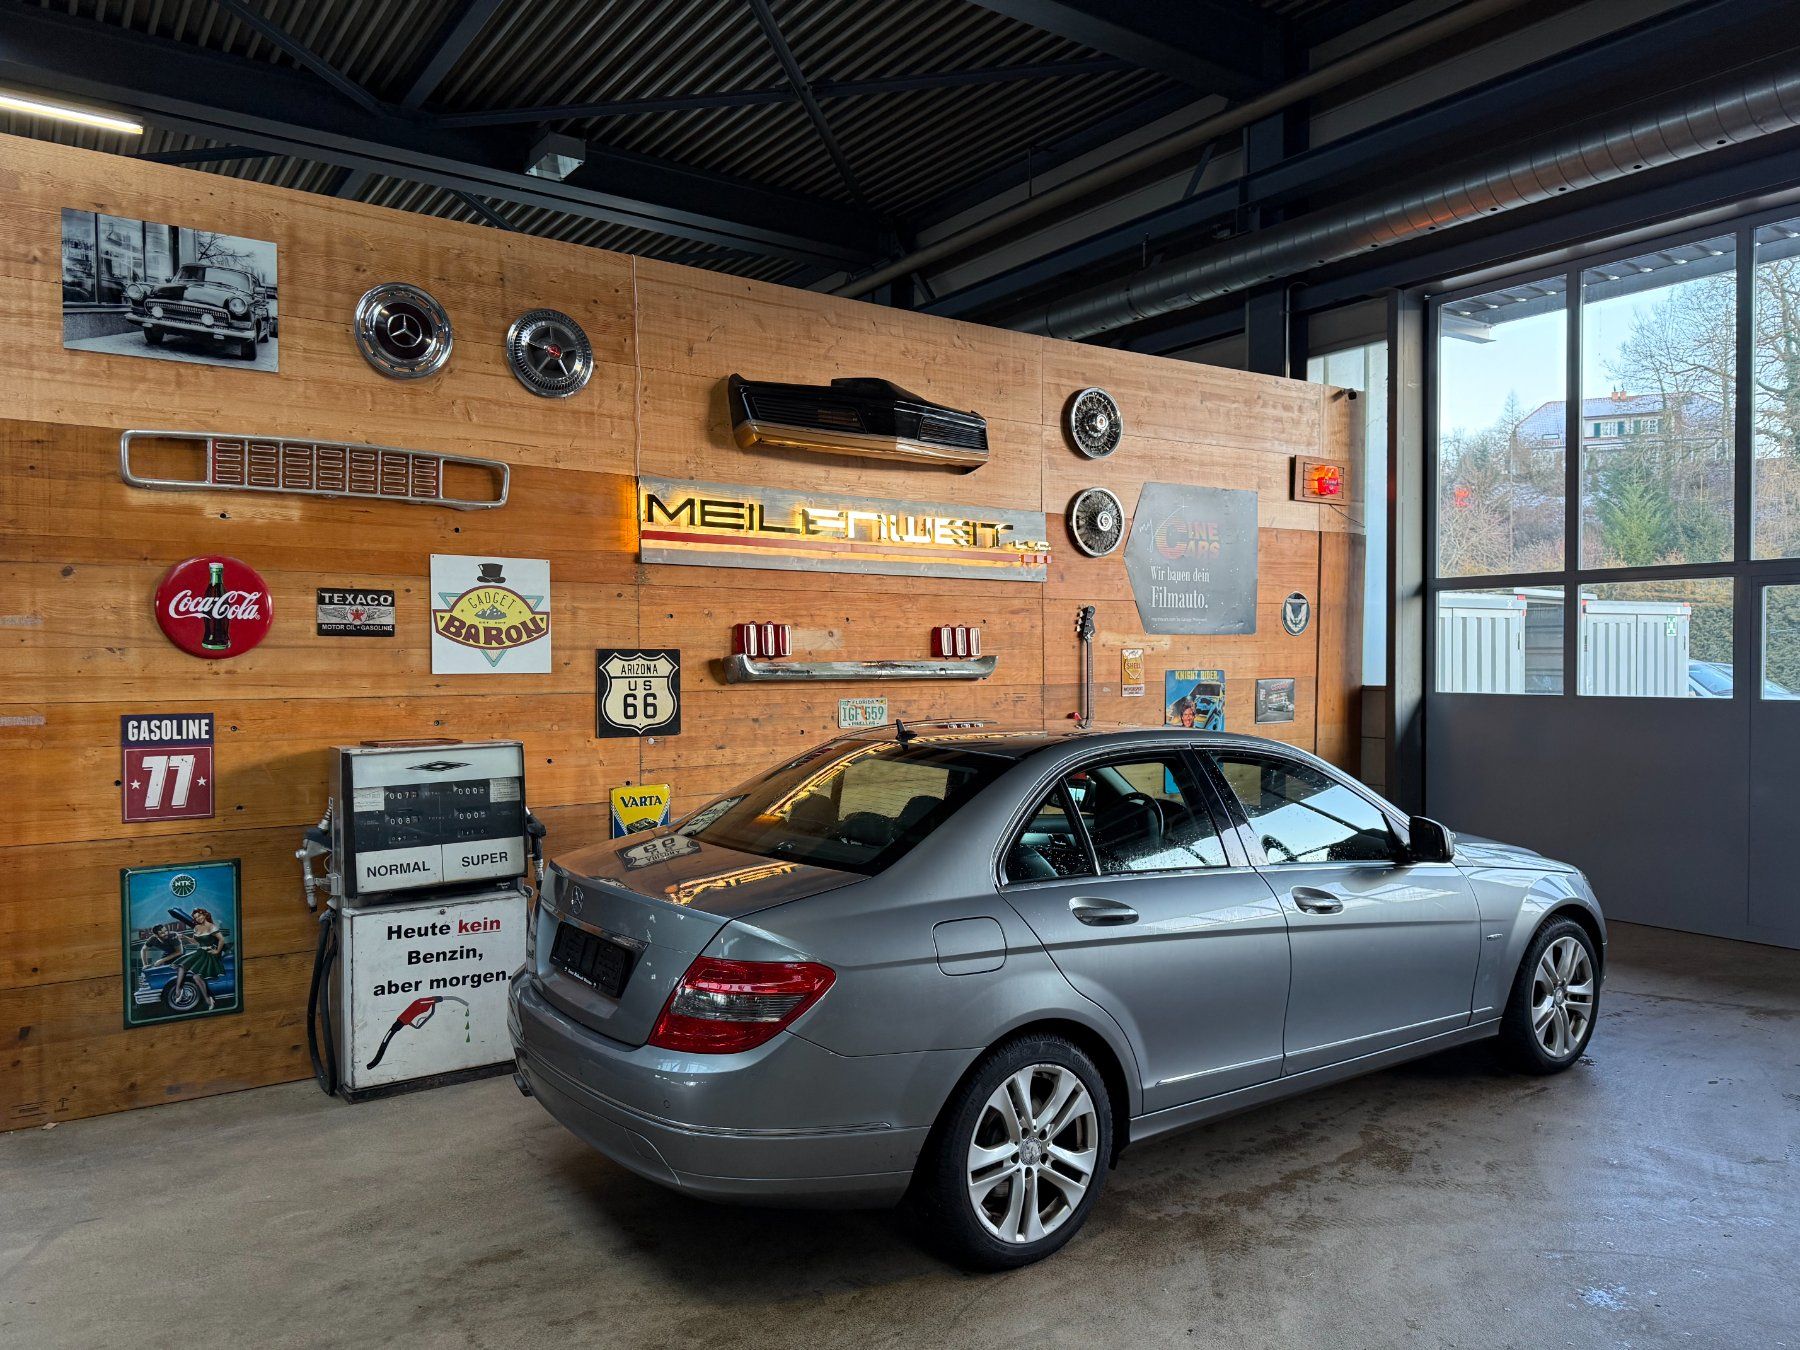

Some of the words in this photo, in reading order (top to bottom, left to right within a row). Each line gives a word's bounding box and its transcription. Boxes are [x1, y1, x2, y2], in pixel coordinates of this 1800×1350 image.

[1150, 565, 1166, 581] Wir
[1167, 566, 1191, 582] bauen
[1192, 567, 1210, 583] dein
[321, 592, 393, 606] TEXACO
[467, 591, 517, 609] GADGET
[1151, 585, 1209, 609] Filmauto.
[440, 613, 546, 646] BARON
[620, 663, 659, 675] ARIZONA
[1175, 670, 1199, 680] KNIGHT
[1200, 670, 1218, 680] RIDER
[623, 692, 658, 720] 66
[127, 719, 210, 741] GASOLINE
[141, 754, 196, 810] 77
[619, 795, 663, 808] VARTA
[366, 860, 431, 878] NORMAL
[461, 851, 509, 868] SUPER
[387, 922, 451, 941] Heute
[458, 917, 501, 935] kein
[407, 945, 484, 966] Benzin,
[373, 979, 423, 997] aber
[429, 970, 512, 990] morgen.
